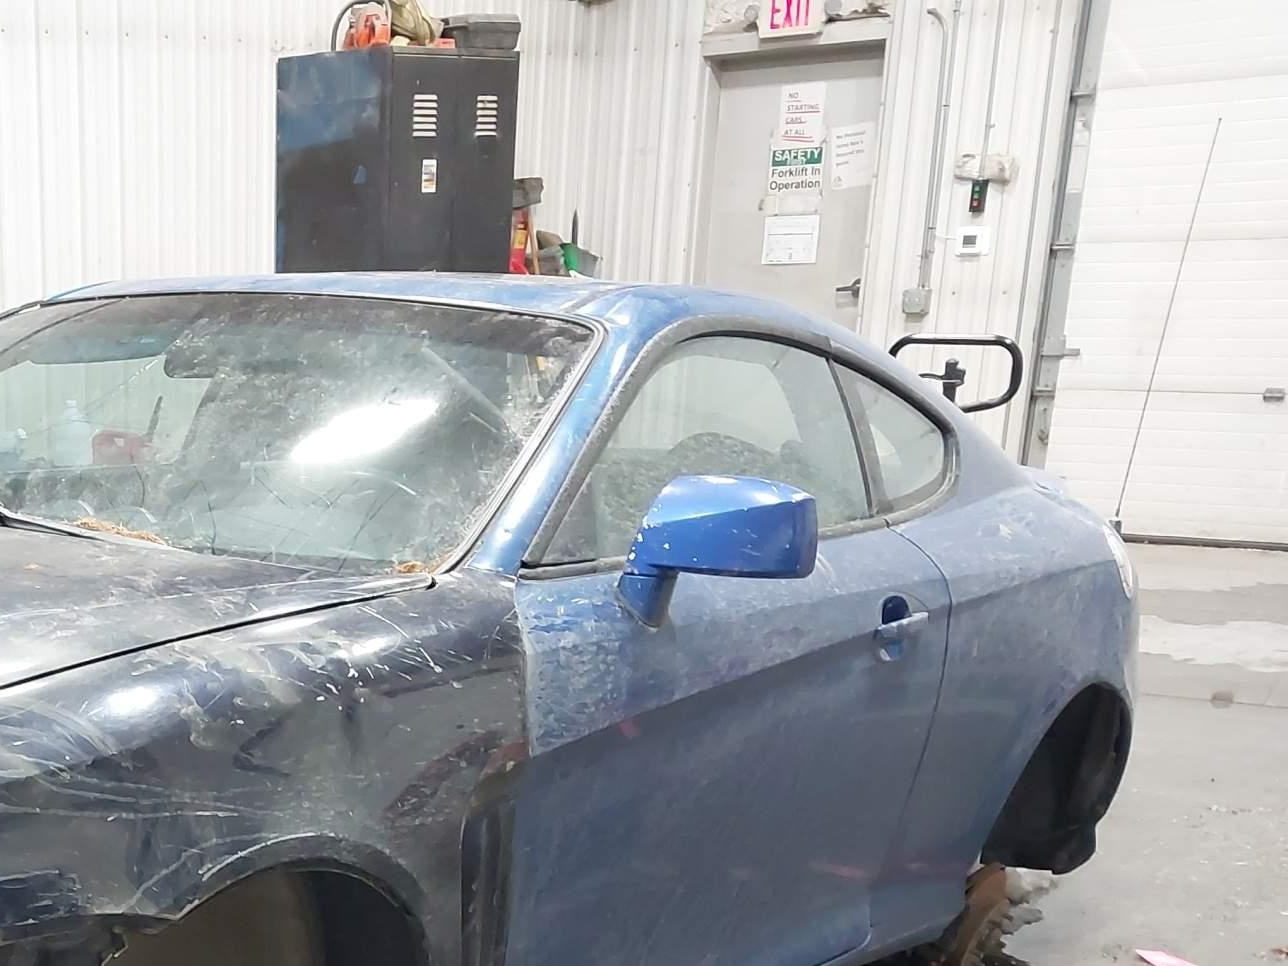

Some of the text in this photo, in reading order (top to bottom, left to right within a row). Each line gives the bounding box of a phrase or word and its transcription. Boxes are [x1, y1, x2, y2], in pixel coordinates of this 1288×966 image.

[769, 0, 810, 29] EXIT
[774, 148, 819, 161] SAFETY
[772, 167, 808, 178] Forklift
[769, 180, 821, 192] Operation
